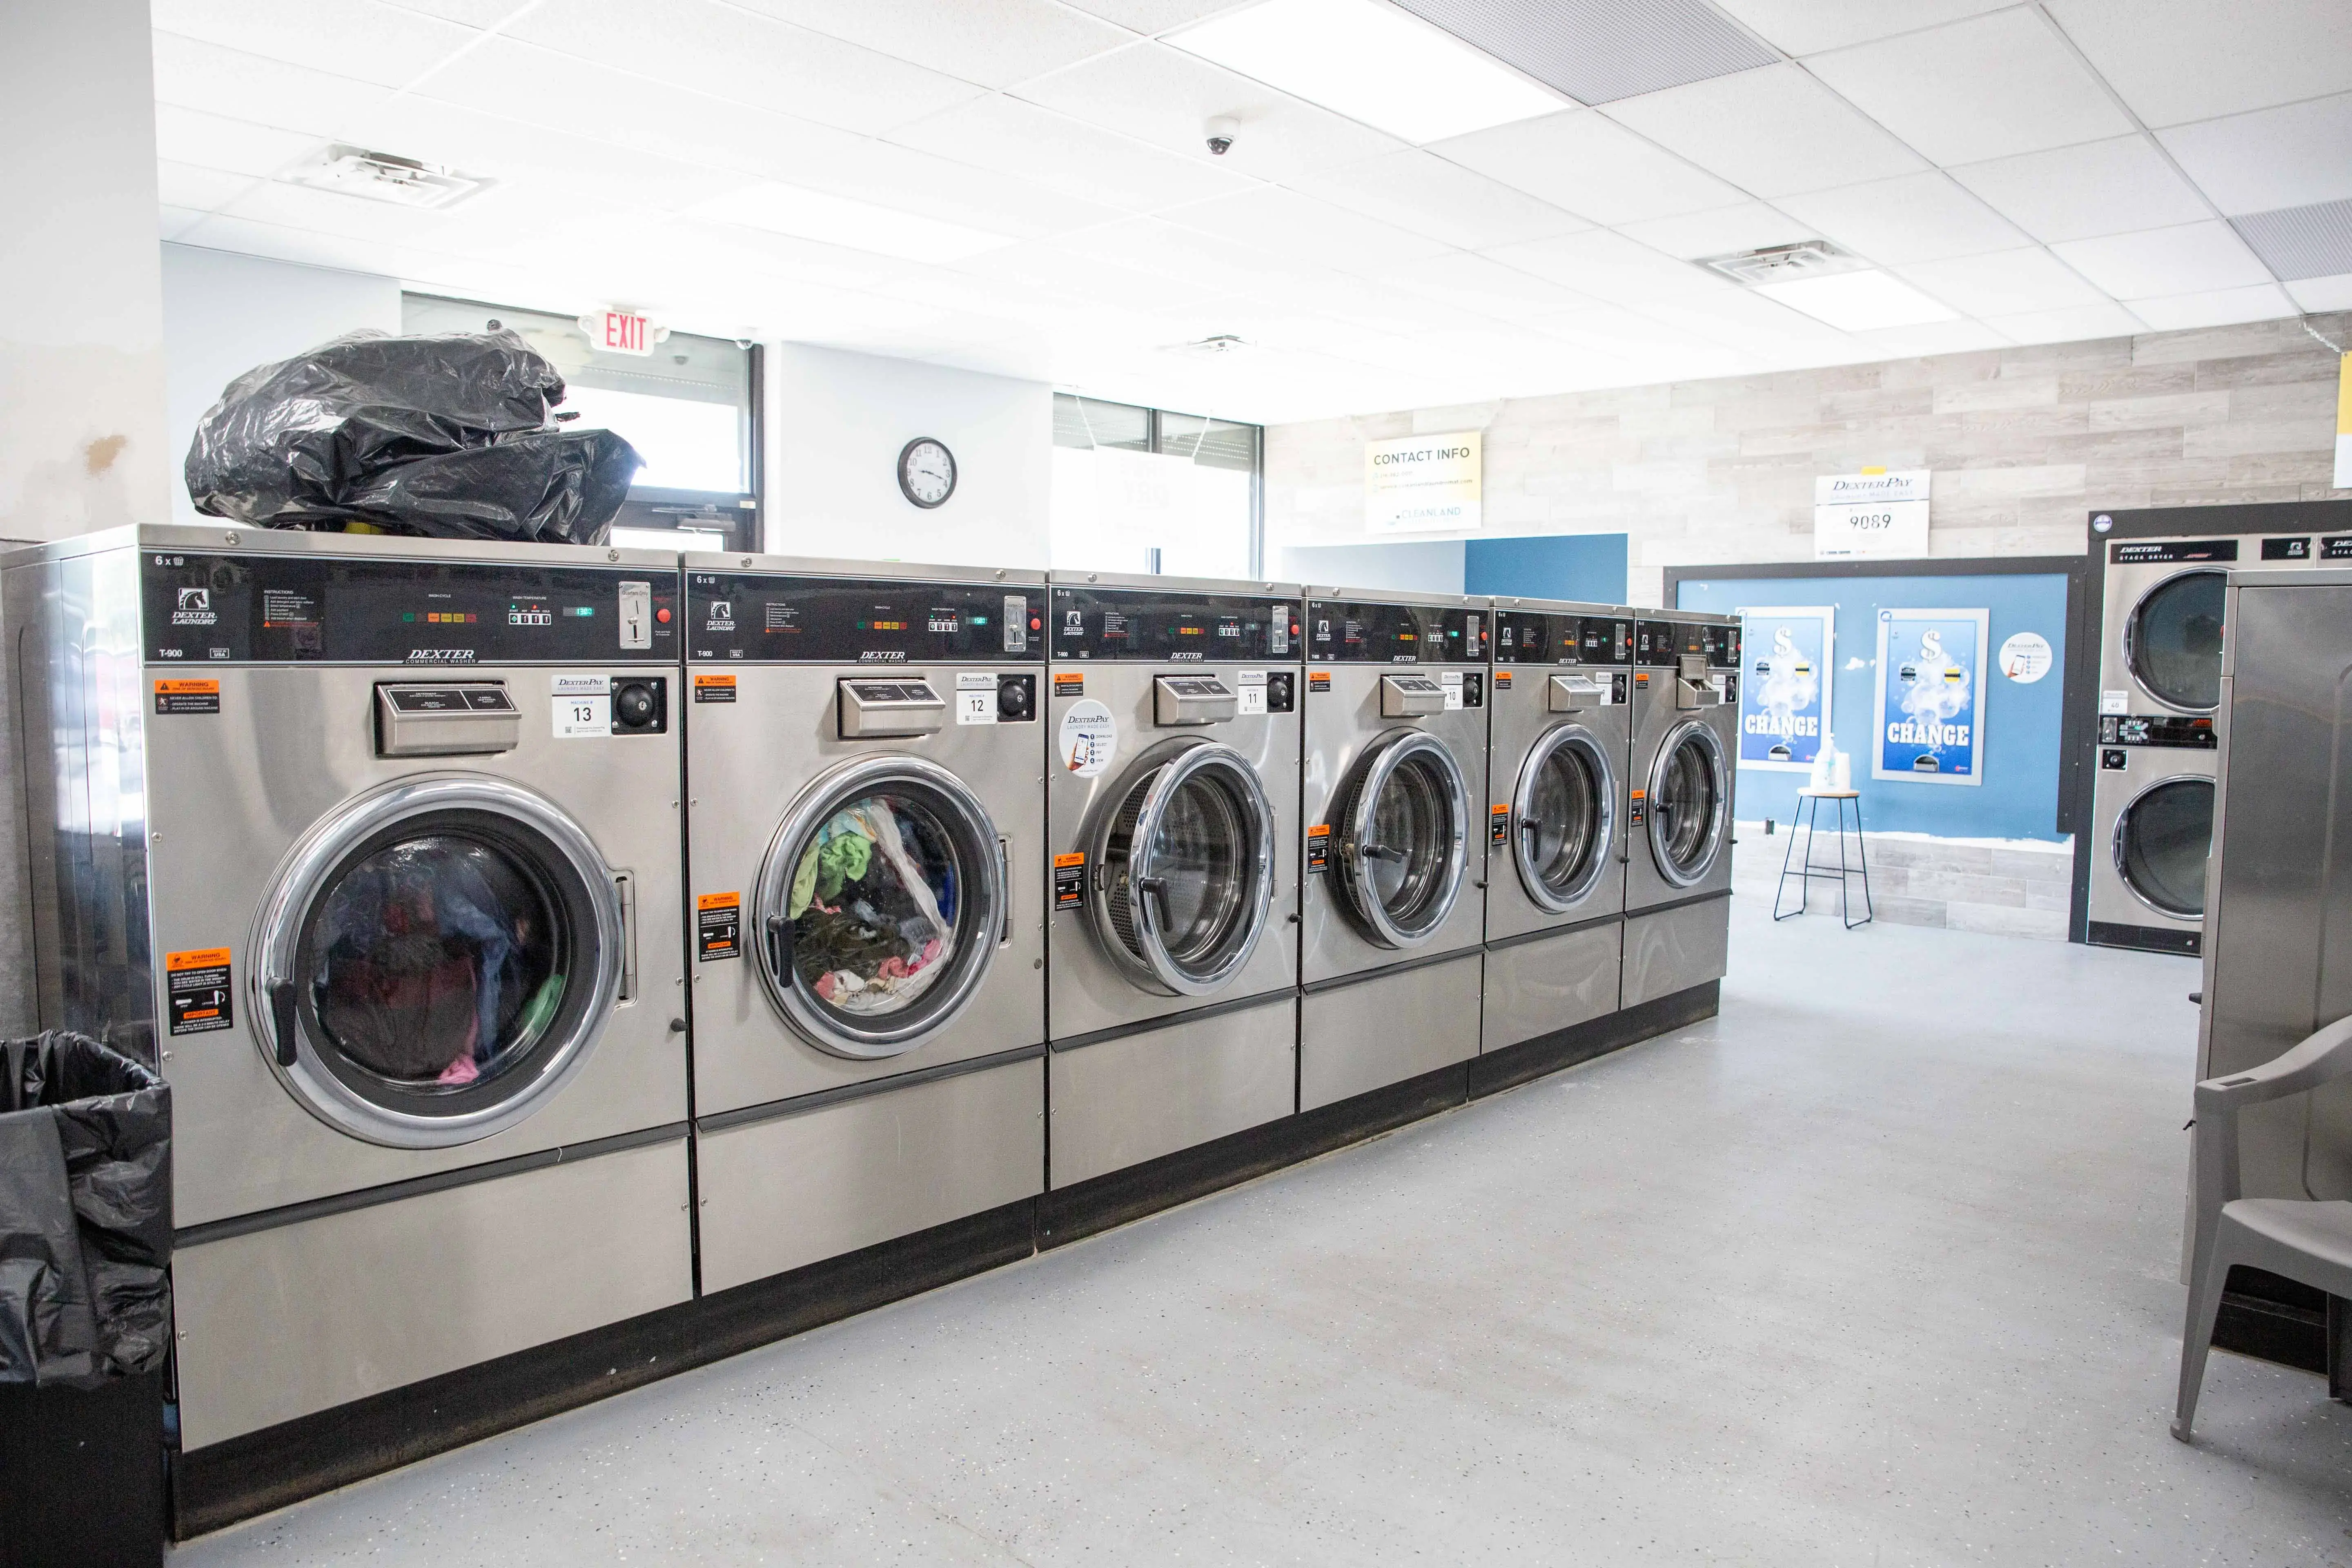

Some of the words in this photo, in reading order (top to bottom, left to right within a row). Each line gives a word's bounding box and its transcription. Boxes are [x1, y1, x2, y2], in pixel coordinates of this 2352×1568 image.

[607, 313, 646, 350] EXIT
[1374, 450, 1432, 465] CONTACT
[1437, 447, 1470, 459] INFO
[910, 479, 914, 487] 8
[918, 488, 921, 497] 7
[1850, 514, 1891, 529] 9089
[155, 556, 163, 565] 6
[408, 650, 474, 659] DEXTER
[1248, 693, 1256, 704] 11
[1449, 692, 1456, 700] 10
[971, 699, 983, 712] 12
[574, 707, 591, 722] 13
[1744, 714, 1818, 737] CHANGE
[1887, 722, 1969, 746] CHANGE
